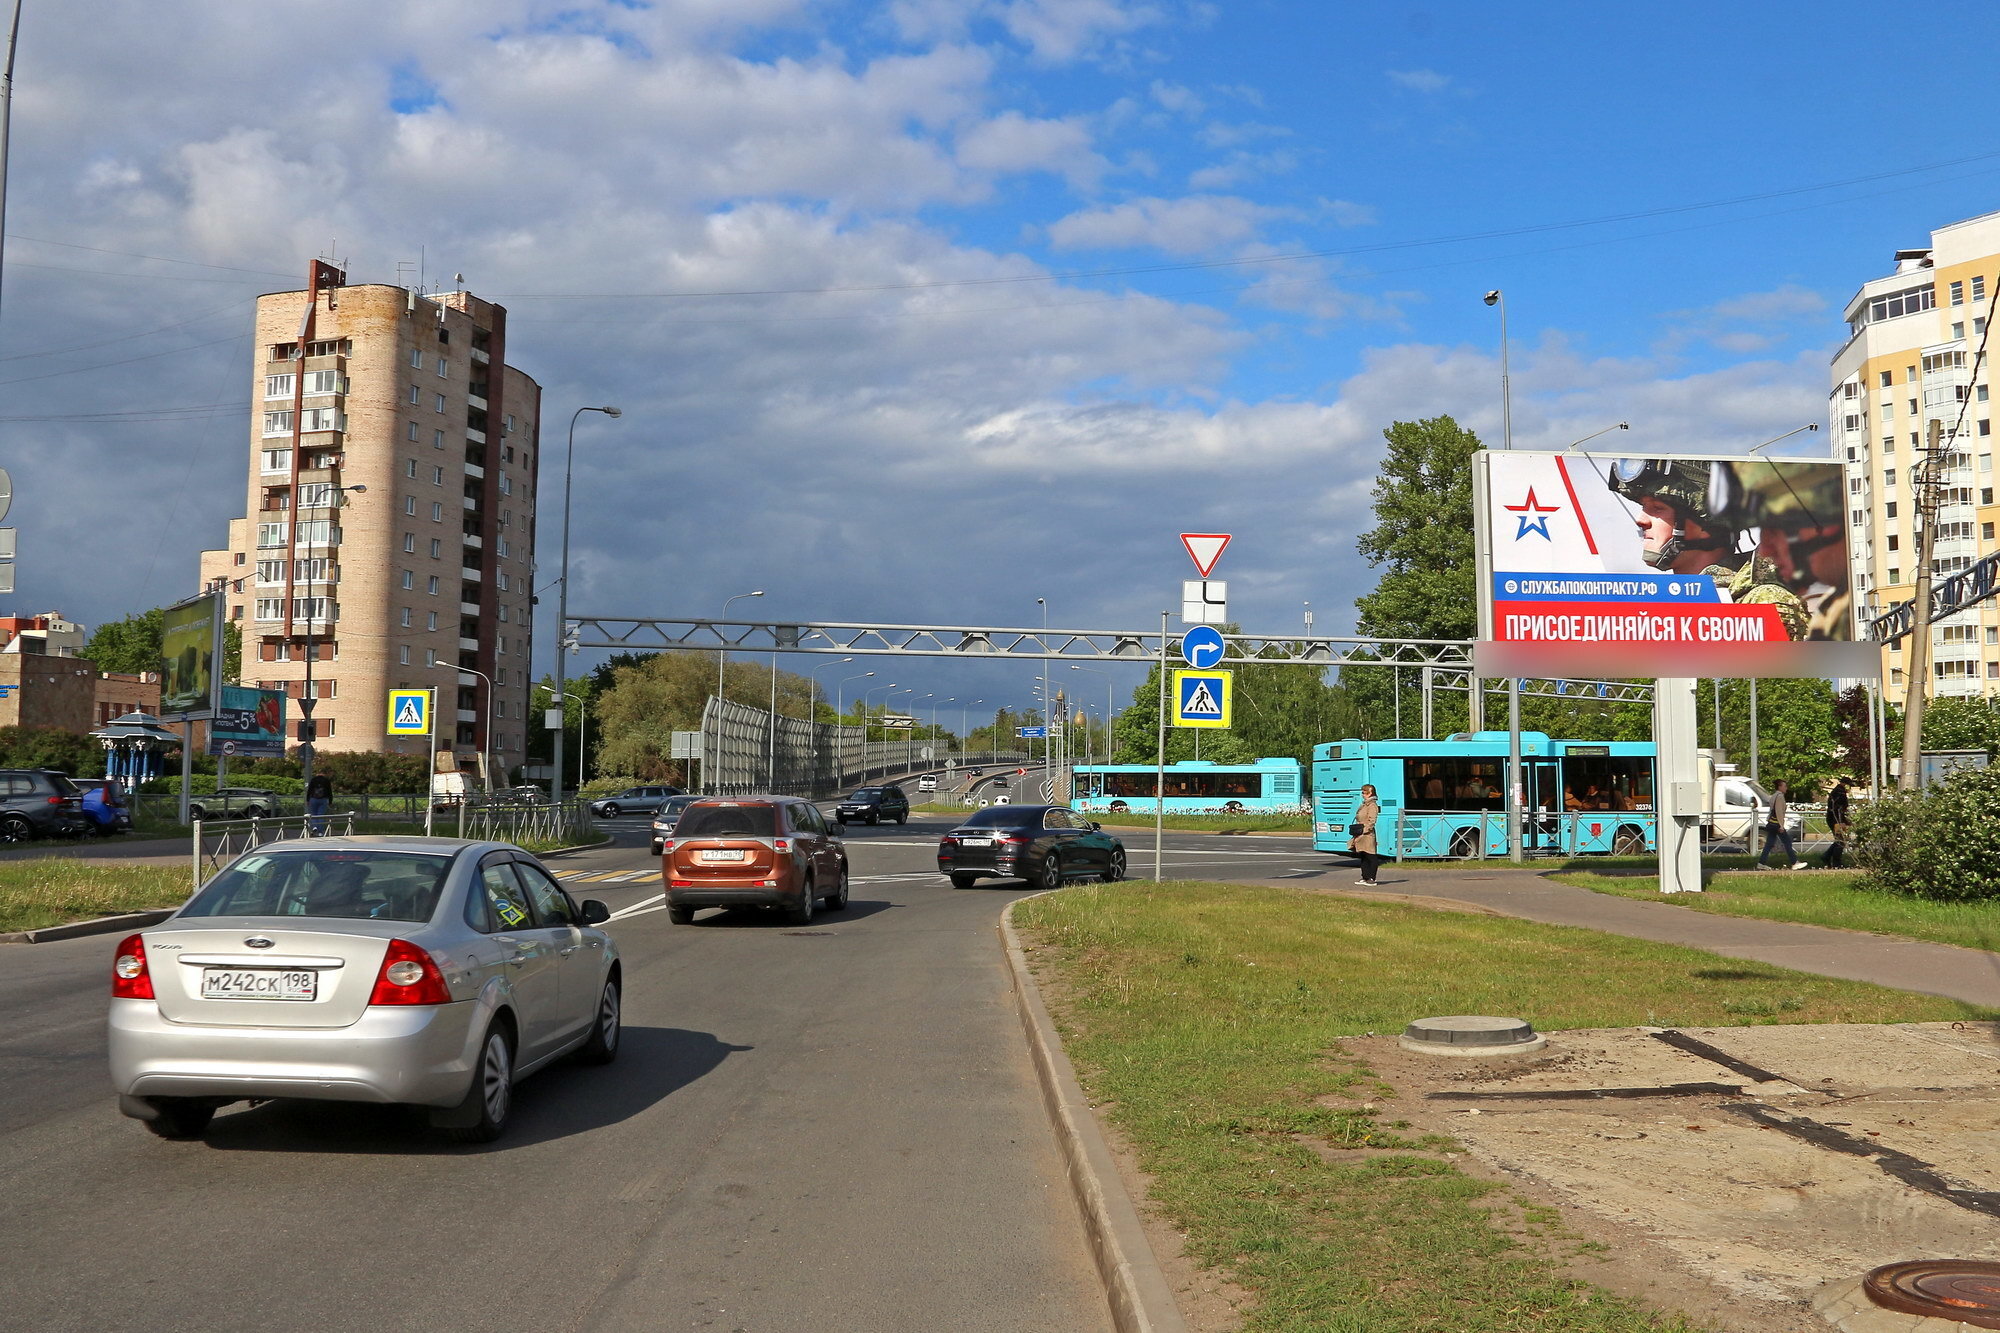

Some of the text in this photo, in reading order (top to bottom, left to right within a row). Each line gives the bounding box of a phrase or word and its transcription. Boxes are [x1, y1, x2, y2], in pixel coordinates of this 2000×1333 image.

[1521, 580, 1702, 596] СЛУЖБАПОКОНТРАКТУ.РФ 117
[1505, 611, 1765, 642] ПРИСОЕДИНЯЙСЯ К СВОИМ
[208, 973, 310, 992] М242СК 198
